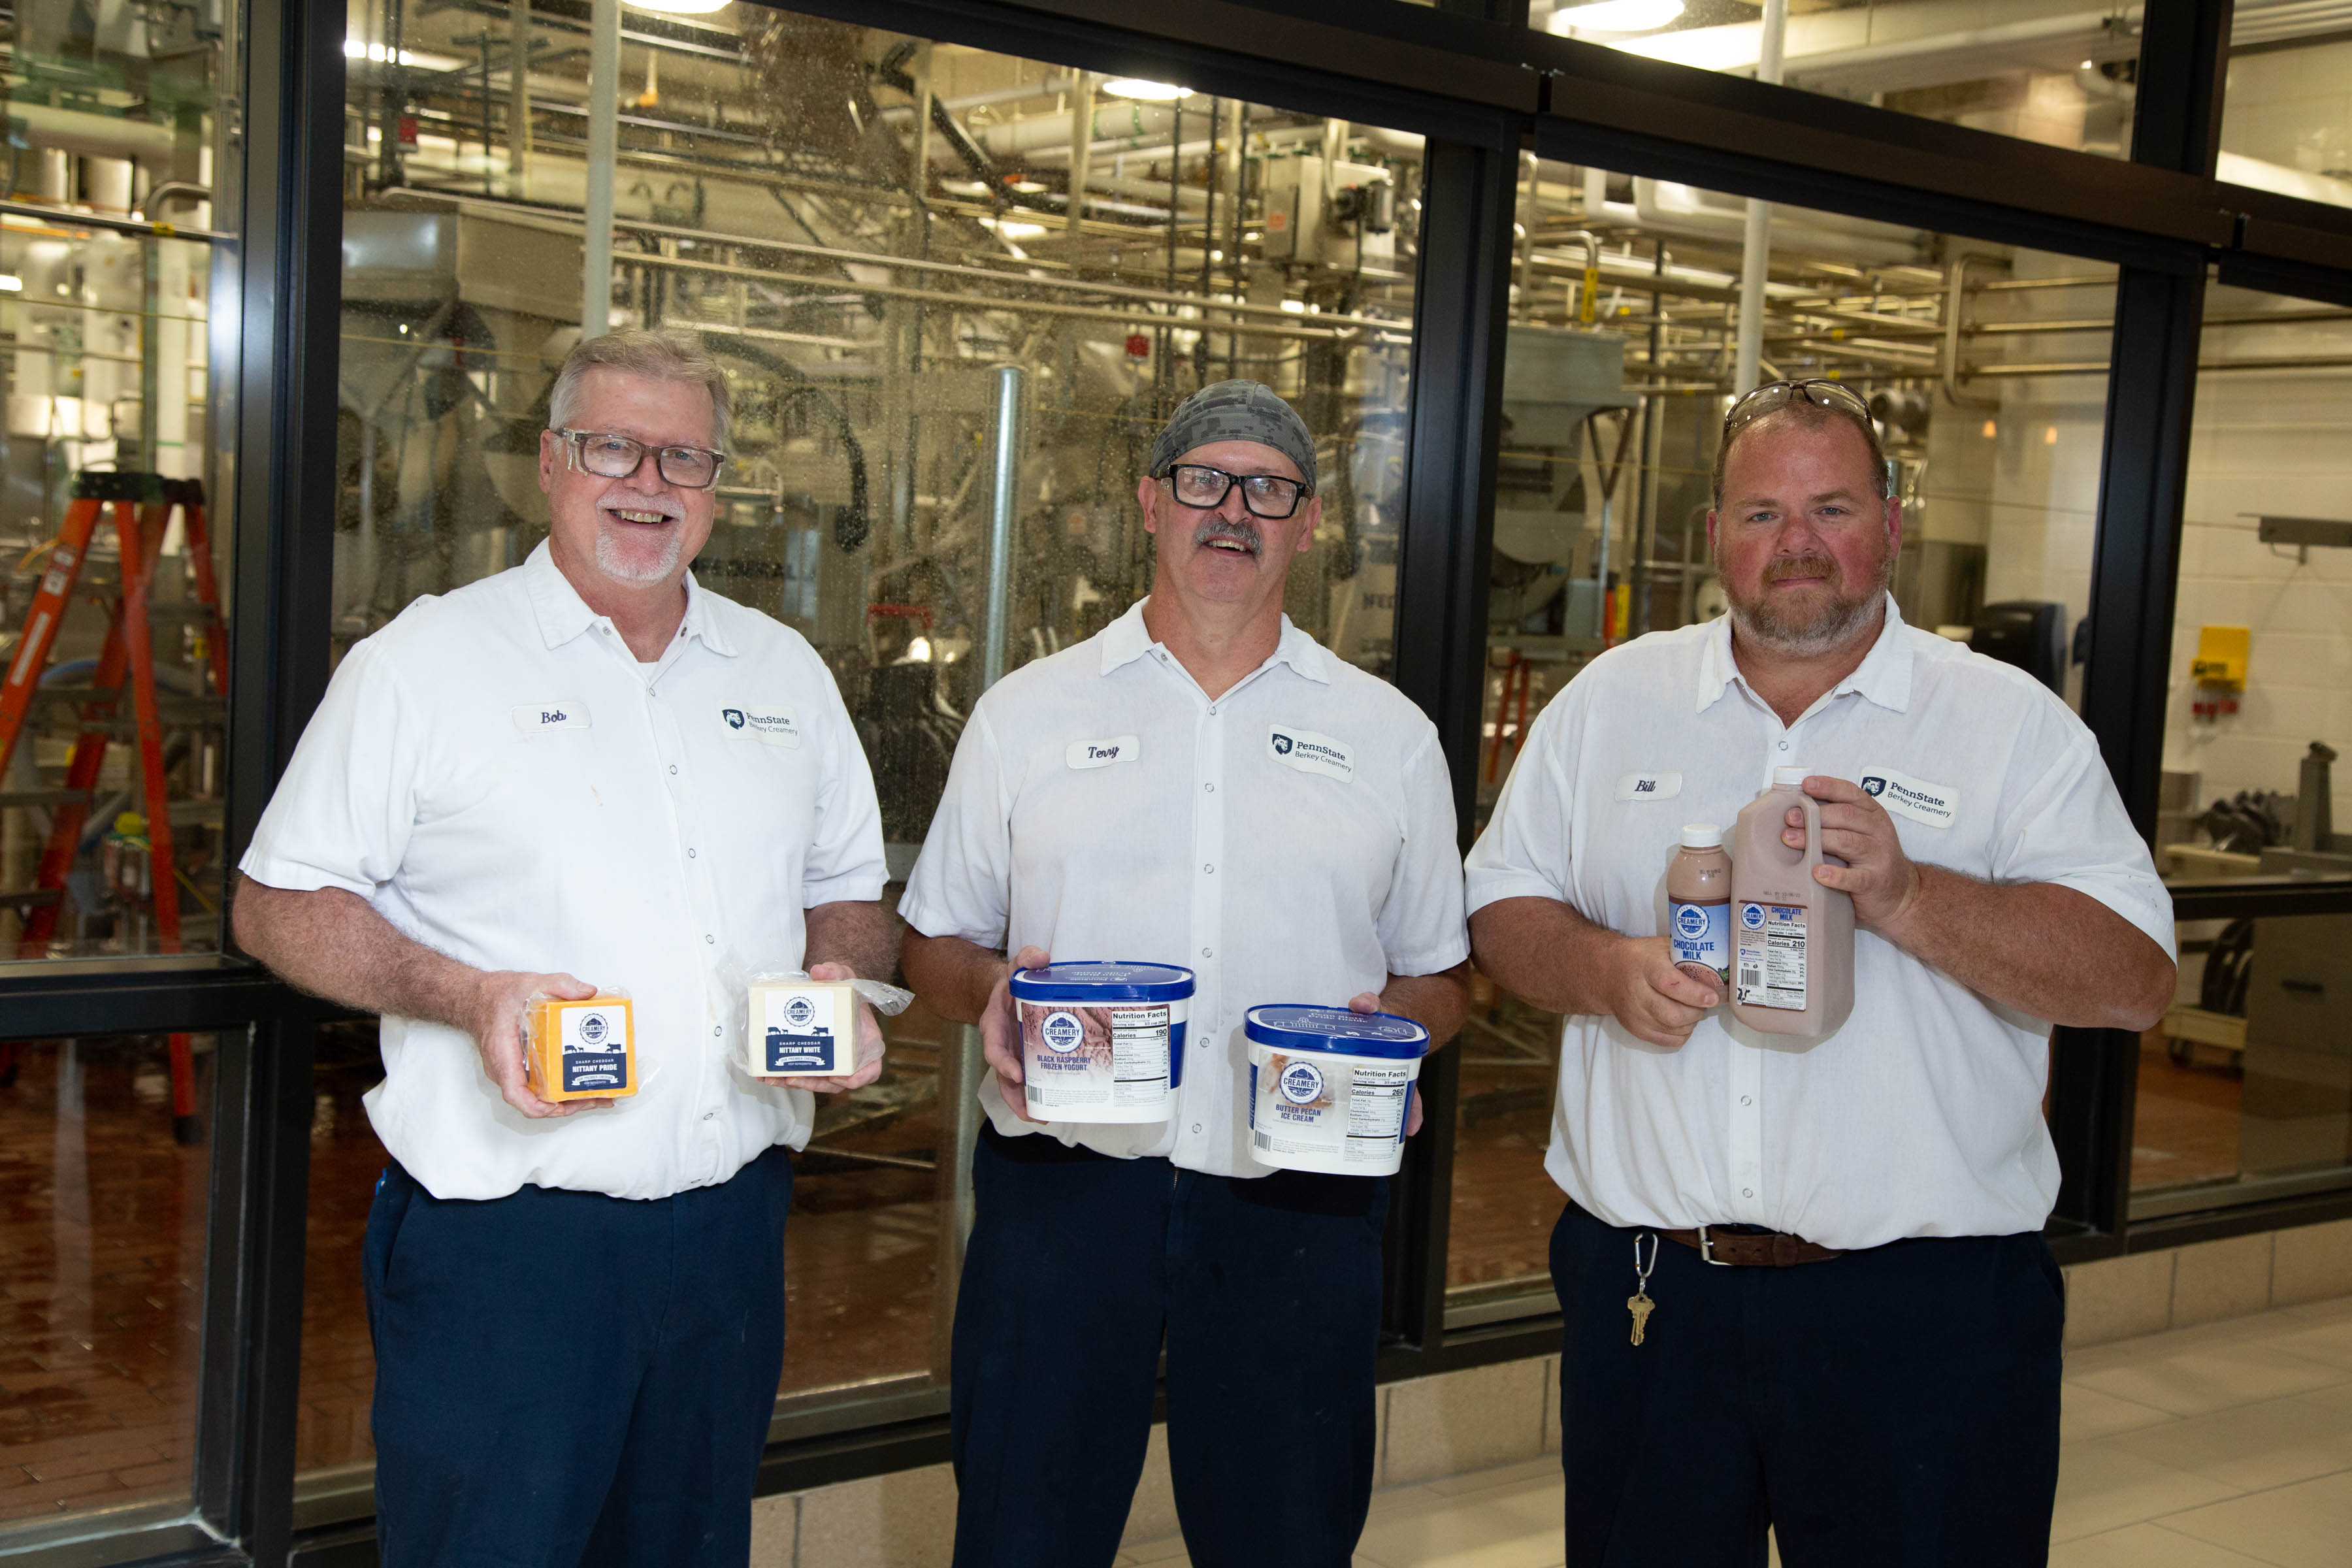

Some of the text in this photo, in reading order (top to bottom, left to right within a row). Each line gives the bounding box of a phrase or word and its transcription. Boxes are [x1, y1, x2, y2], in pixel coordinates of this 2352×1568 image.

[541, 710, 566, 723] Bob
[768, 726, 798, 736] Creamery
[1088, 746, 1119, 759] Terry
[1297, 741, 1346, 760] PennState
[1295, 751, 1352, 772] Berkey Creamery
[1635, 780, 1656, 792] Bill
[1890, 781, 1945, 806] PennState
[1887, 791, 1952, 818] Berkey Creamery
[1771, 906, 1802, 915] CHOCOLATE
[1678, 917, 1706, 926] CREAMERY
[1673, 939, 1715, 951] CHOCOLATE
[1683, 950, 1701, 960] MILK
[1045, 1028, 1080, 1036] CREAMERY
[1037, 1054, 1092, 1064] BLACK RASPBERRY
[572, 1064, 597, 1073] NITTANY
[1283, 1077, 1319, 1088] CREAMERY
[1276, 1104, 1321, 1116] BUTTER PECAN
[1292, 1114, 1314, 1122] CREAM
